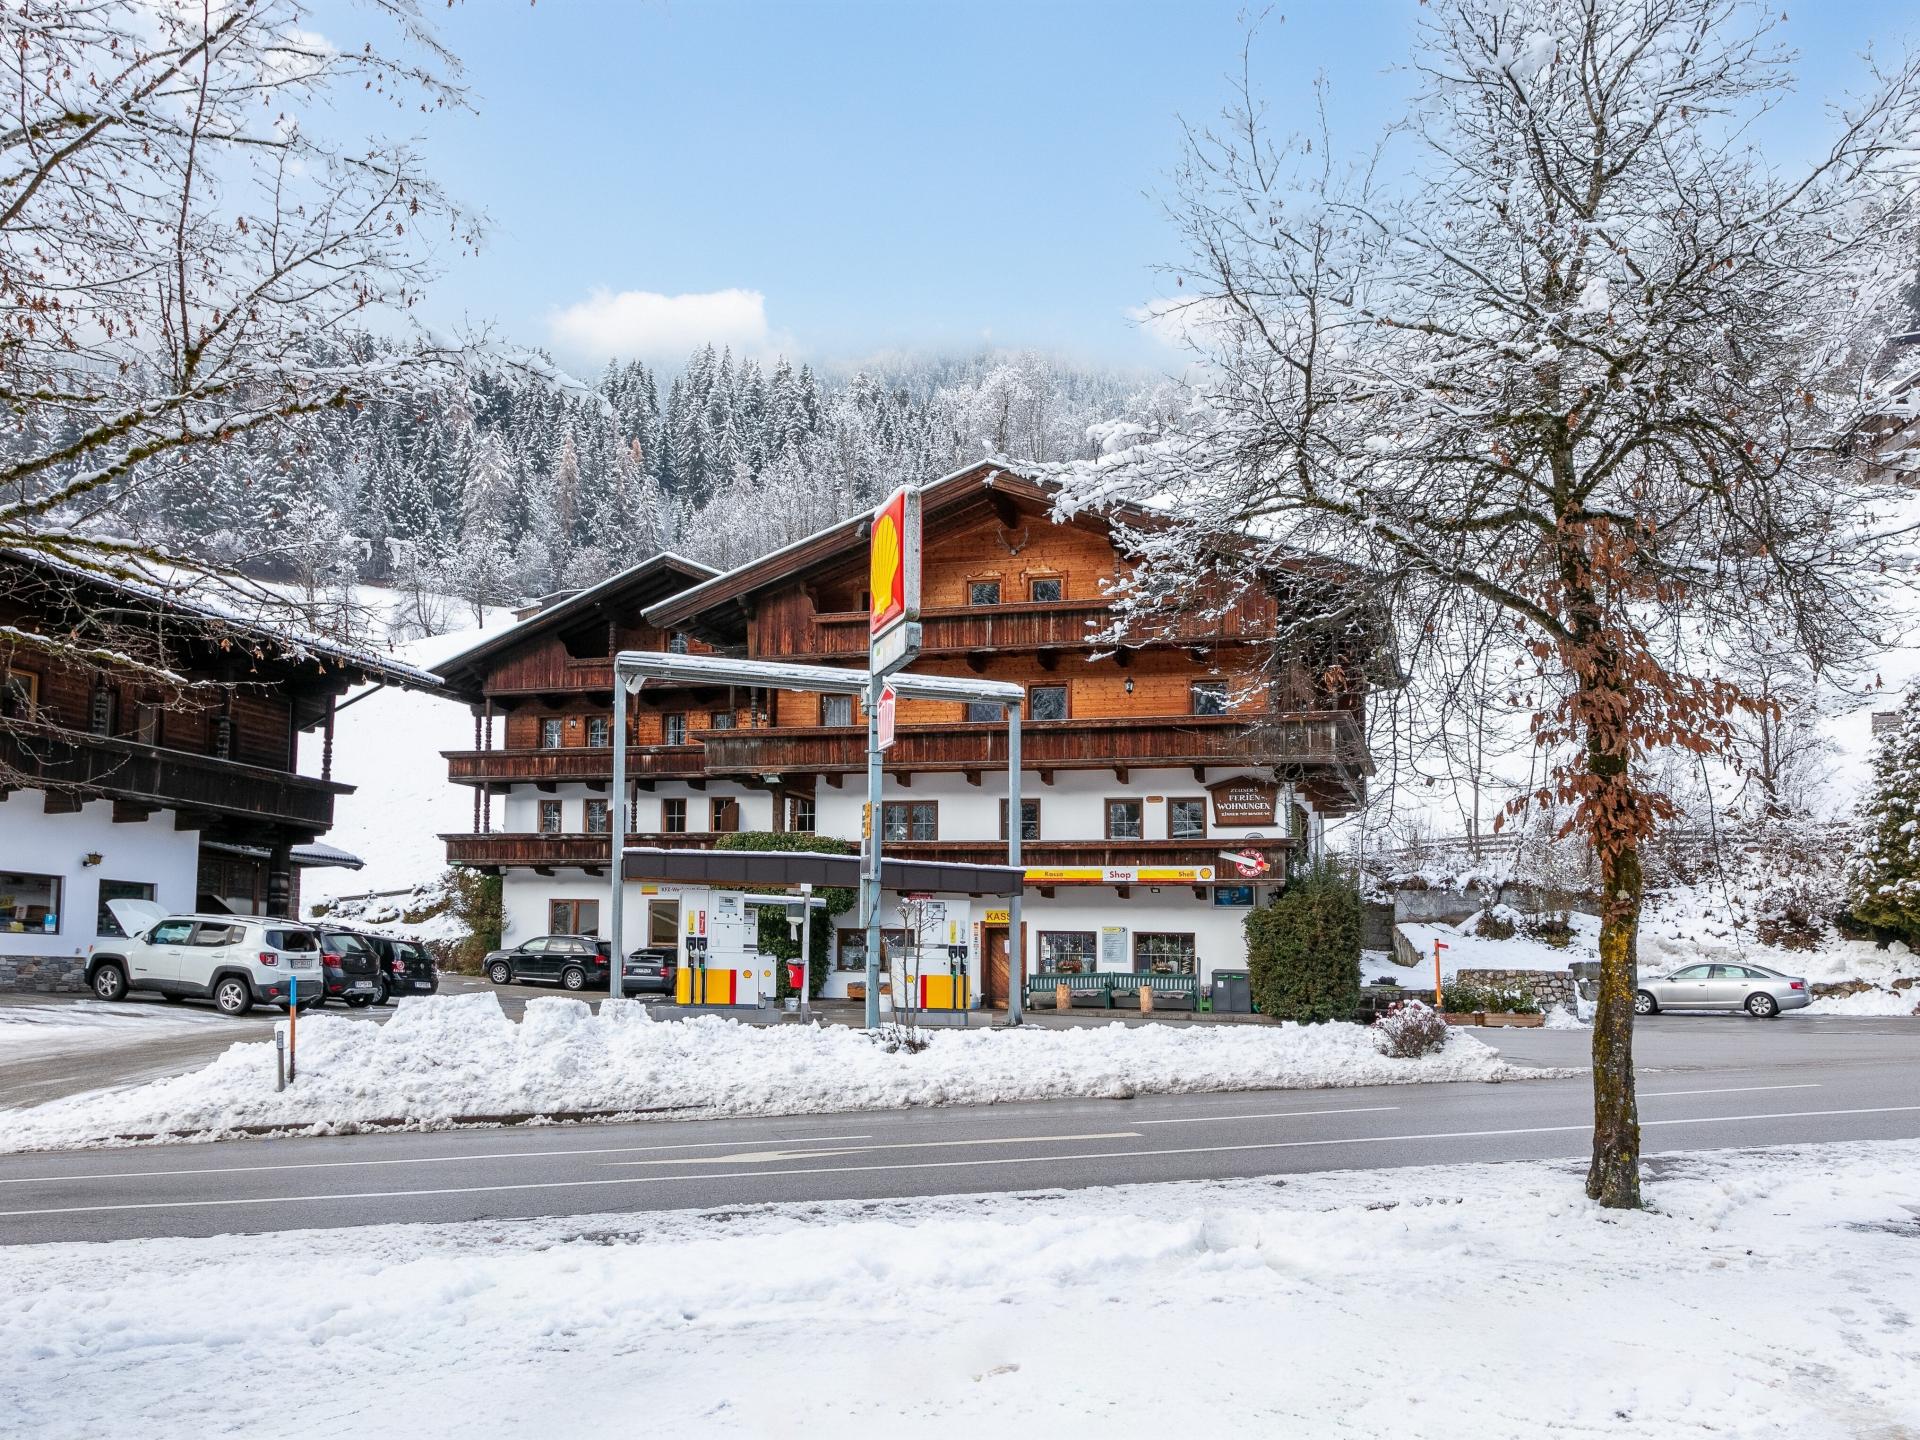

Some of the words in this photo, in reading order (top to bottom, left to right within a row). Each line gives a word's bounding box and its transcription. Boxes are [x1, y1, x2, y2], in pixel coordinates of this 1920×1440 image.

[1217, 802, 1271, 810] WOHNUNGEN
[1109, 870, 1131, 880] Shop
[986, 912, 1011, 921] KASS
